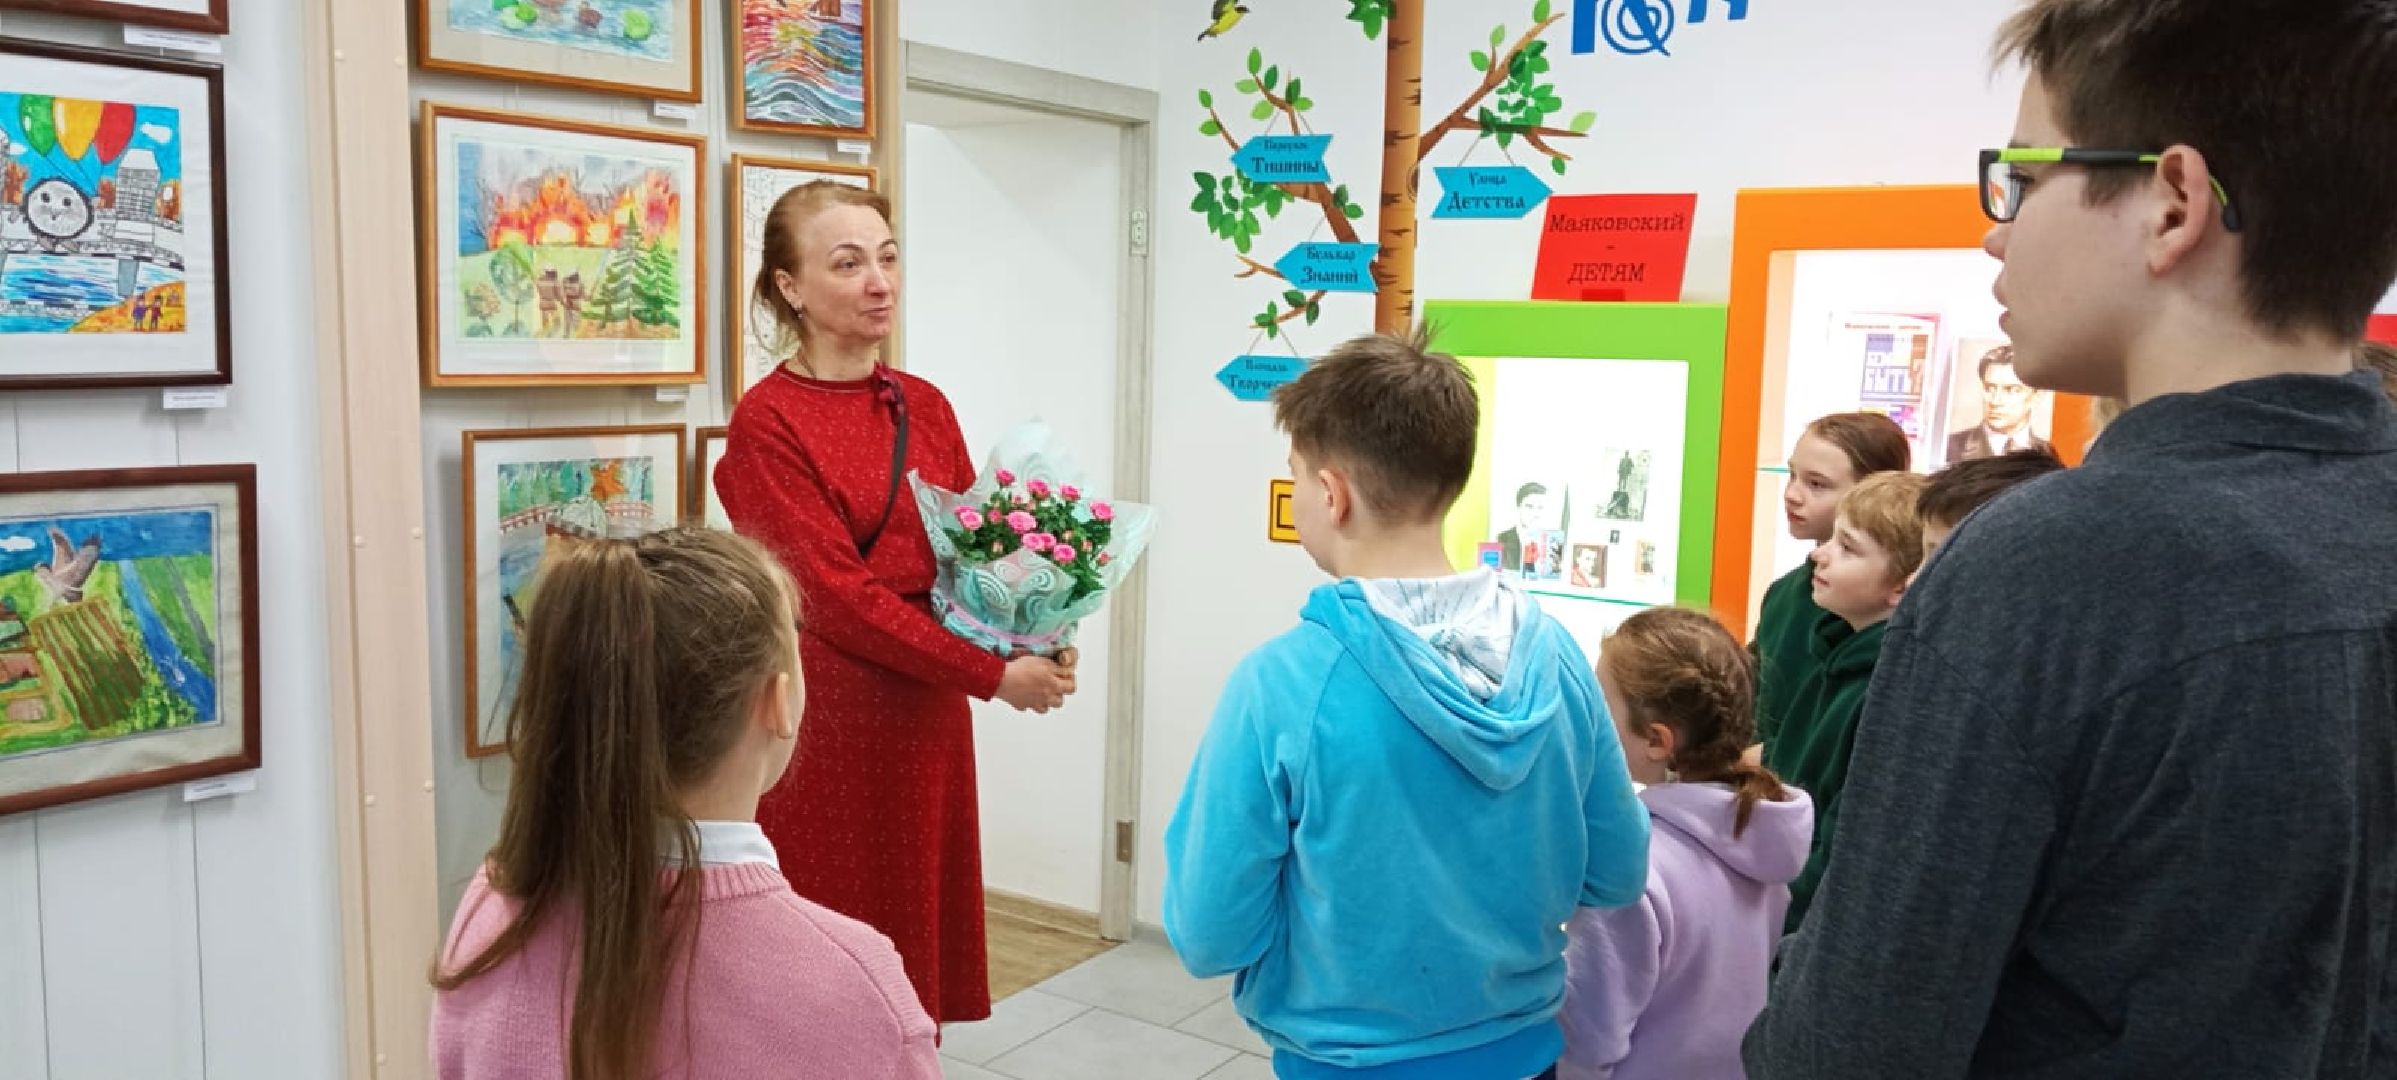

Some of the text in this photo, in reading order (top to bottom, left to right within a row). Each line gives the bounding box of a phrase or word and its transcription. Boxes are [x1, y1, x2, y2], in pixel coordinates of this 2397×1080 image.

[1251, 156, 1319, 174] Тишины
[1468, 172, 1507, 187] Улица
[1447, 190, 1525, 212] Детства
[1549, 213, 1685, 232] Маяковский
[1306, 246, 1356, 263] Бульвар
[1300, 265, 1358, 284] Знаний
[1567, 262, 1646, 284] ДЕТЯМ
